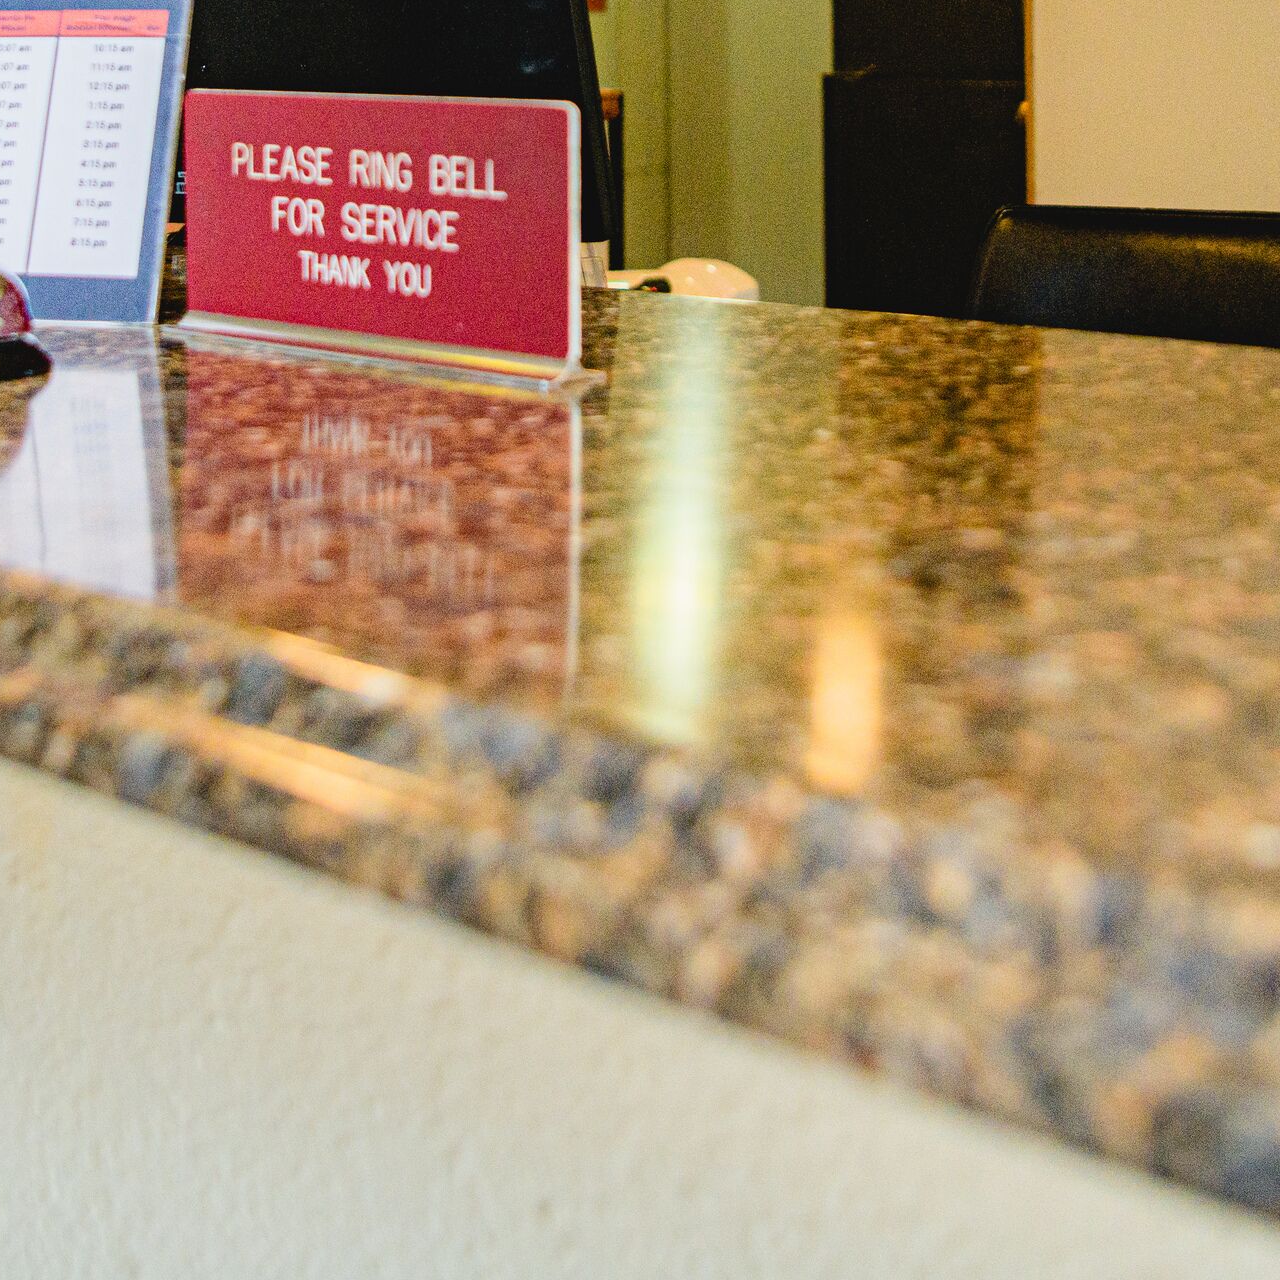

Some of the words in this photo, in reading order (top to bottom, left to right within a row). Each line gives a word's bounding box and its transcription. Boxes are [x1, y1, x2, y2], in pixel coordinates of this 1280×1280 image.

[231, 141, 334, 186] PLEASE
[349, 148, 414, 193] RING
[428, 153, 509, 202] BELL
[271, 195, 326, 237] FOR
[340, 201, 461, 253] SERVICE
[297, 249, 372, 289] THANK
[382, 260, 433, 298] YOU
